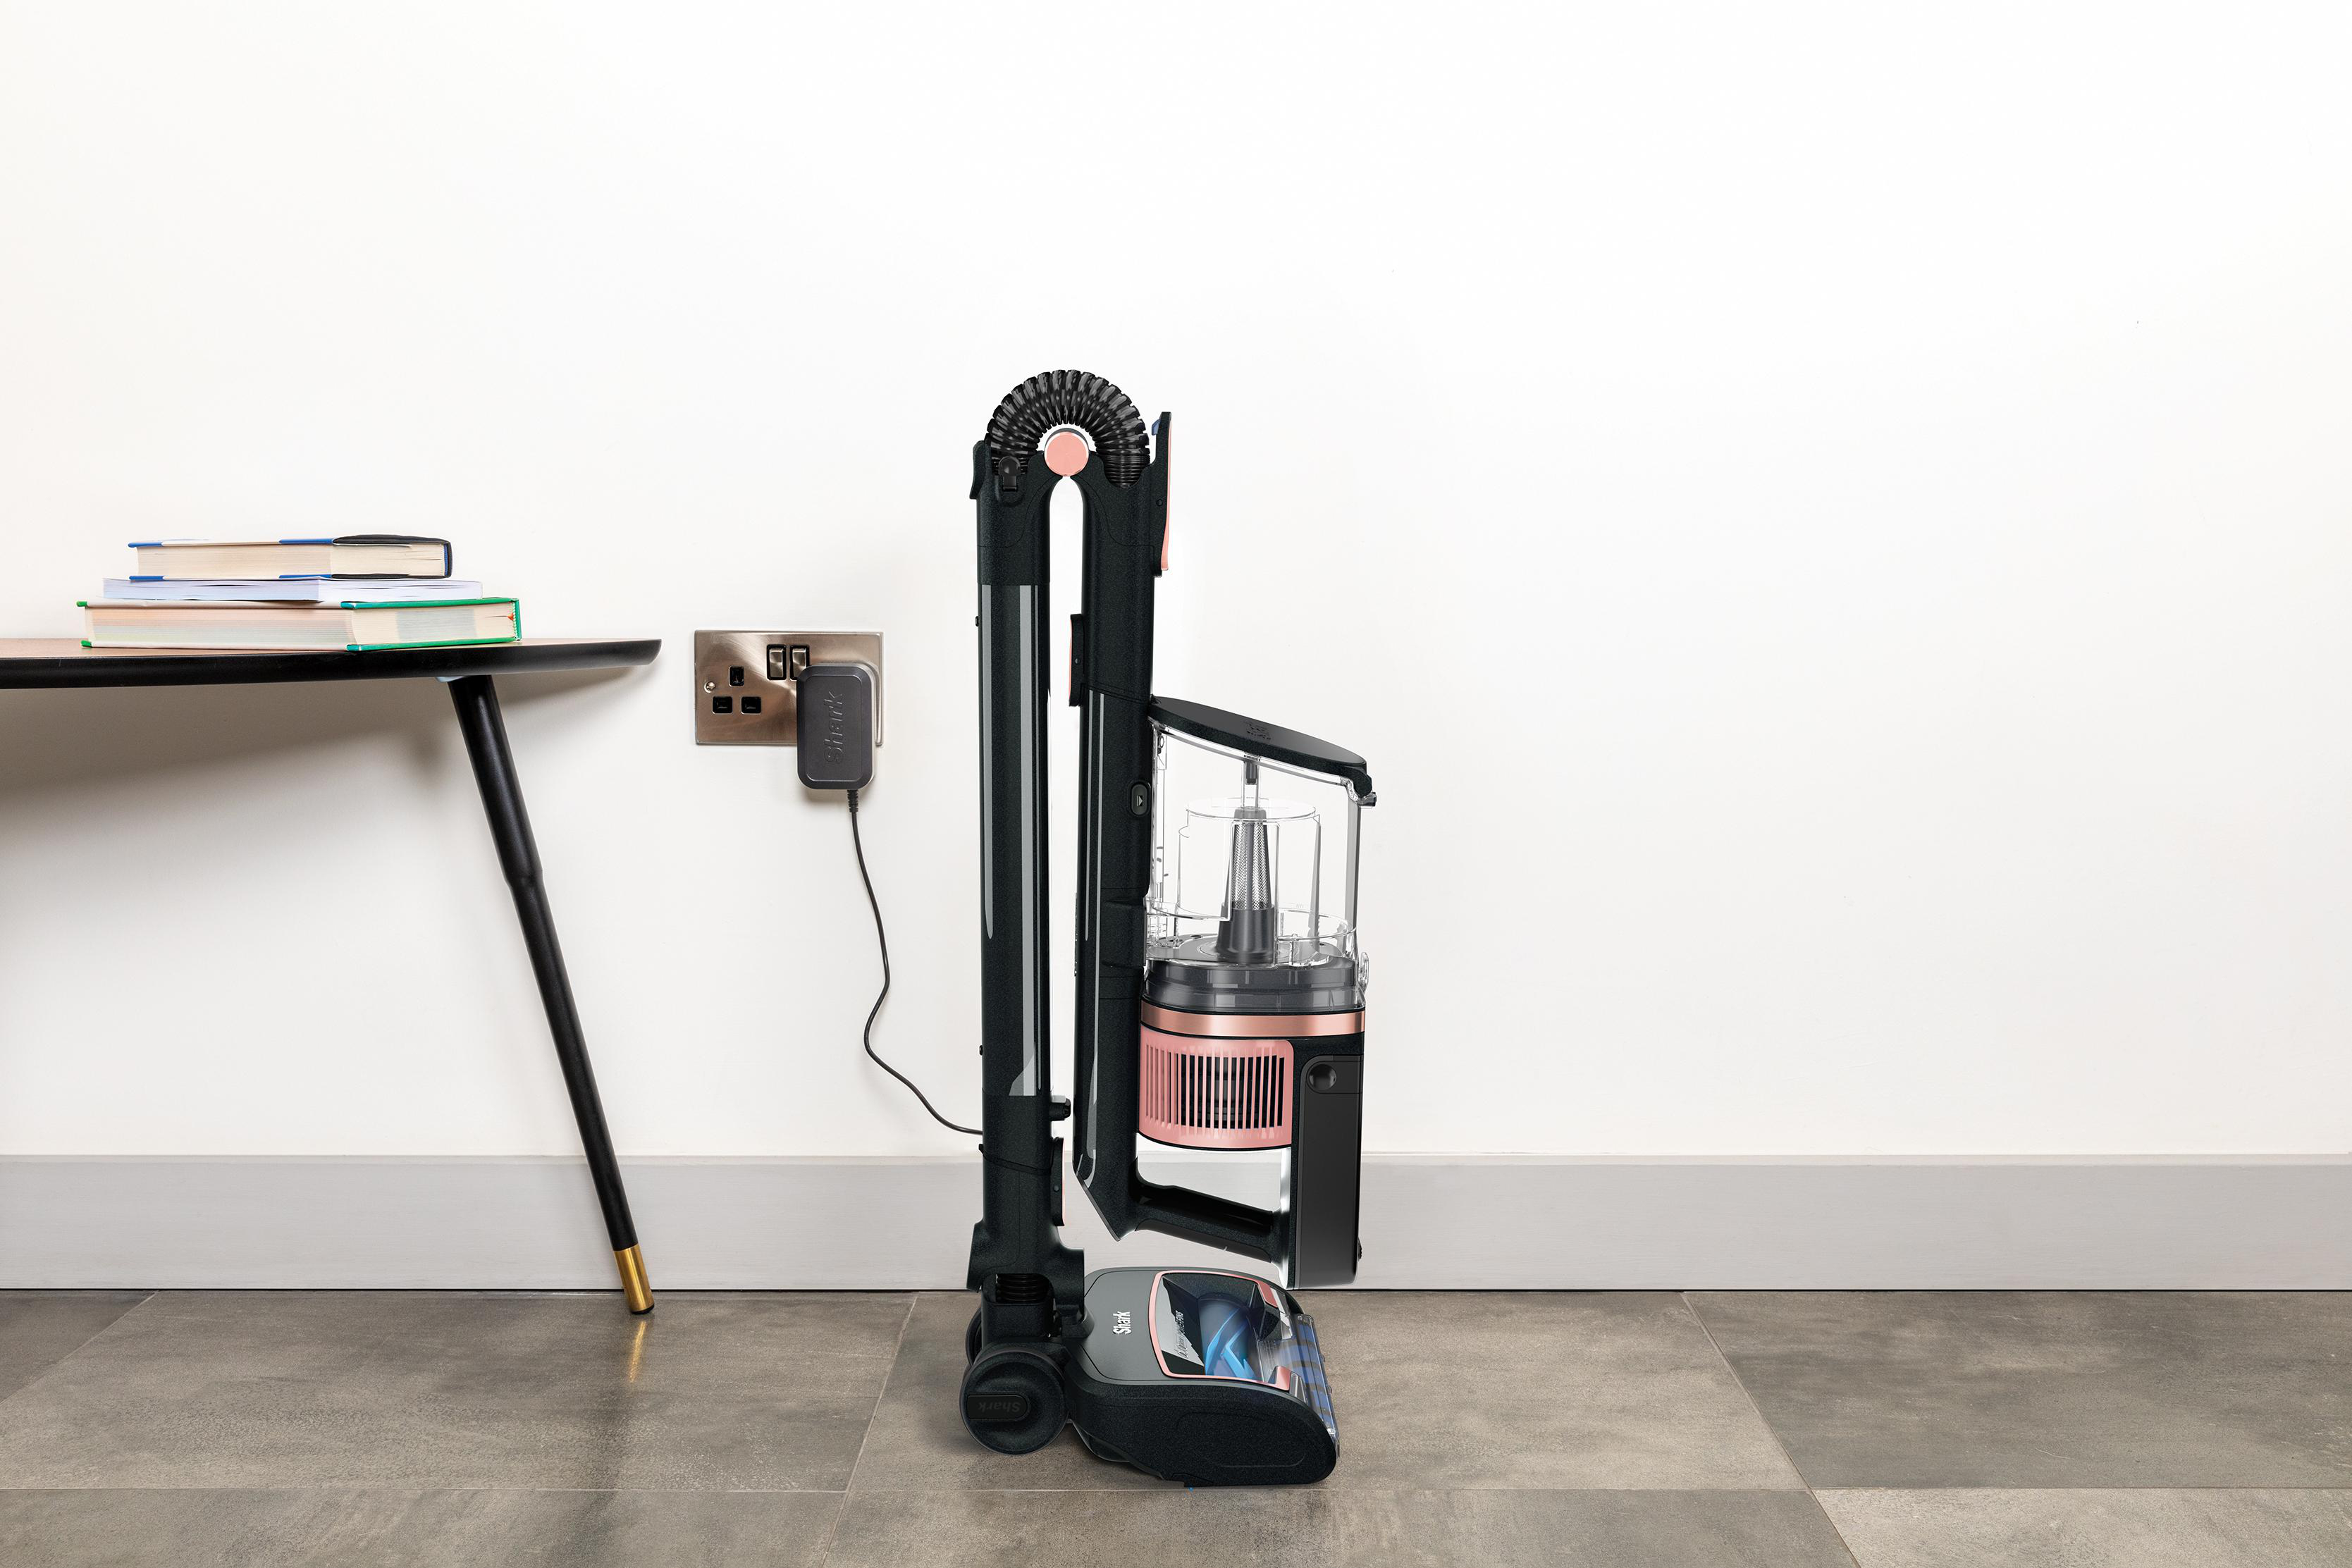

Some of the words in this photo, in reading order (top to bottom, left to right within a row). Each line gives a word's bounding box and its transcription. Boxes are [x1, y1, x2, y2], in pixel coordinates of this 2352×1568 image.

[823, 691, 844, 763] Shark
[1113, 1311, 1132, 1334] Shark
[978, 1402, 1021, 1412] Shark
